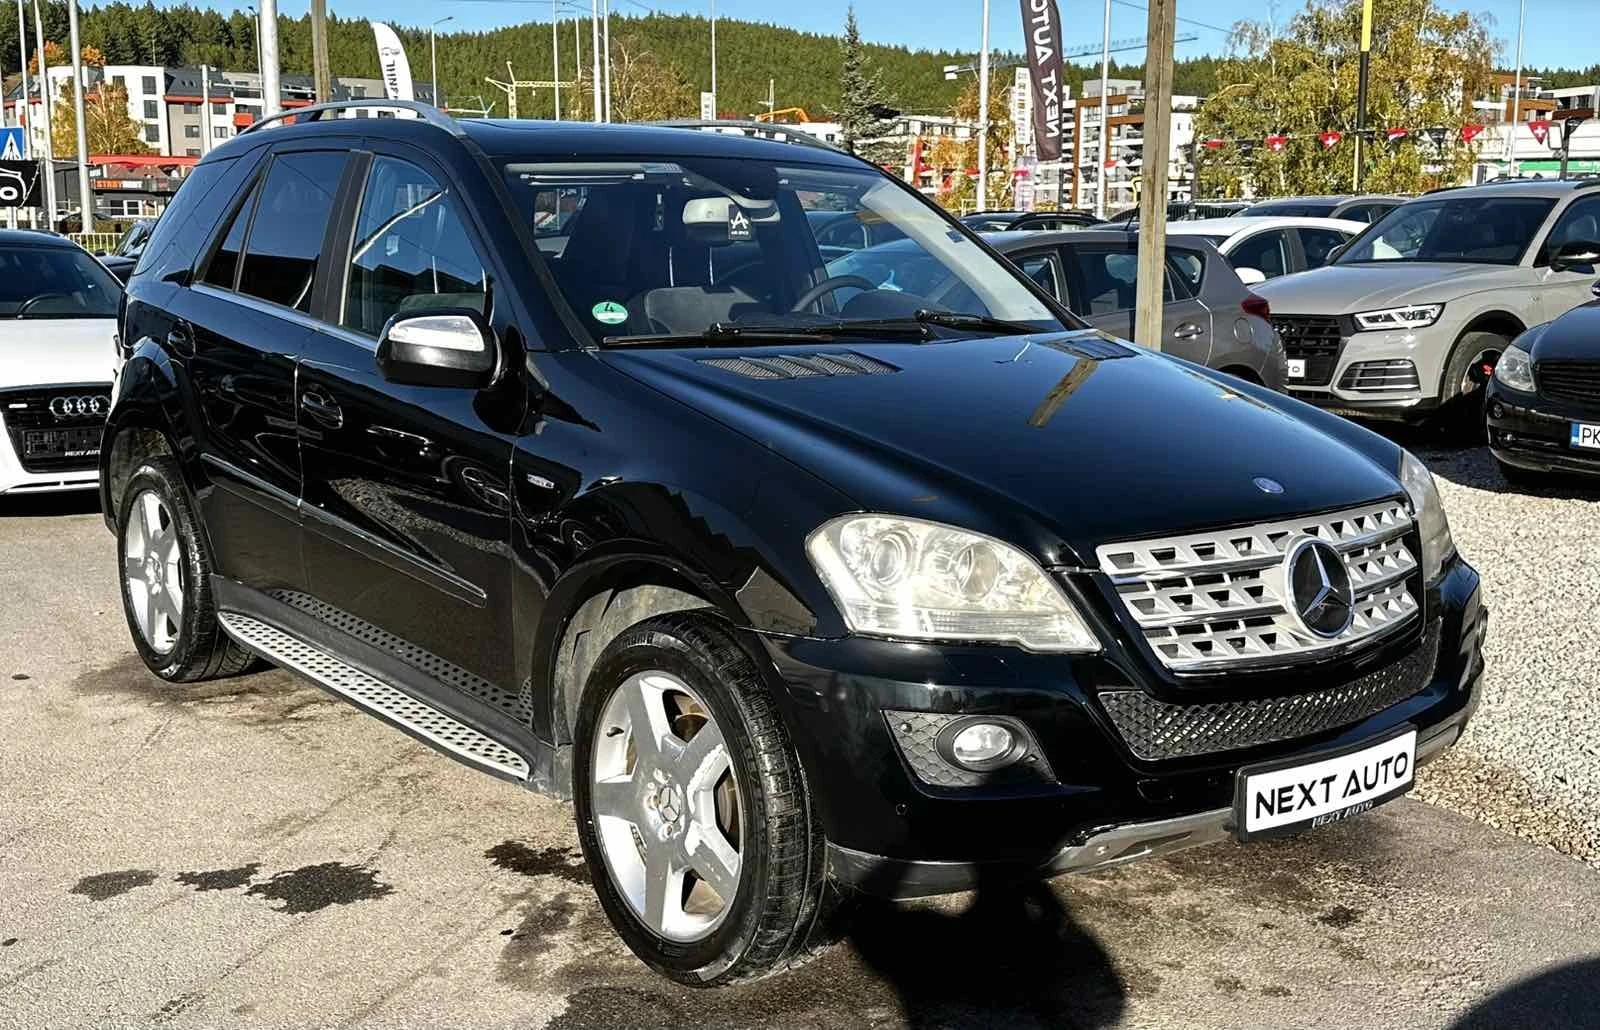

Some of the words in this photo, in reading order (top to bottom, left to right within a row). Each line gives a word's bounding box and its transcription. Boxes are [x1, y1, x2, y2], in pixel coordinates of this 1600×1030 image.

[1255, 774, 1338, 820] NEXT
[1342, 751, 1409, 799] AUTO
[1312, 808, 1344, 829] NEXT
[1343, 800, 1374, 818] AUTO
